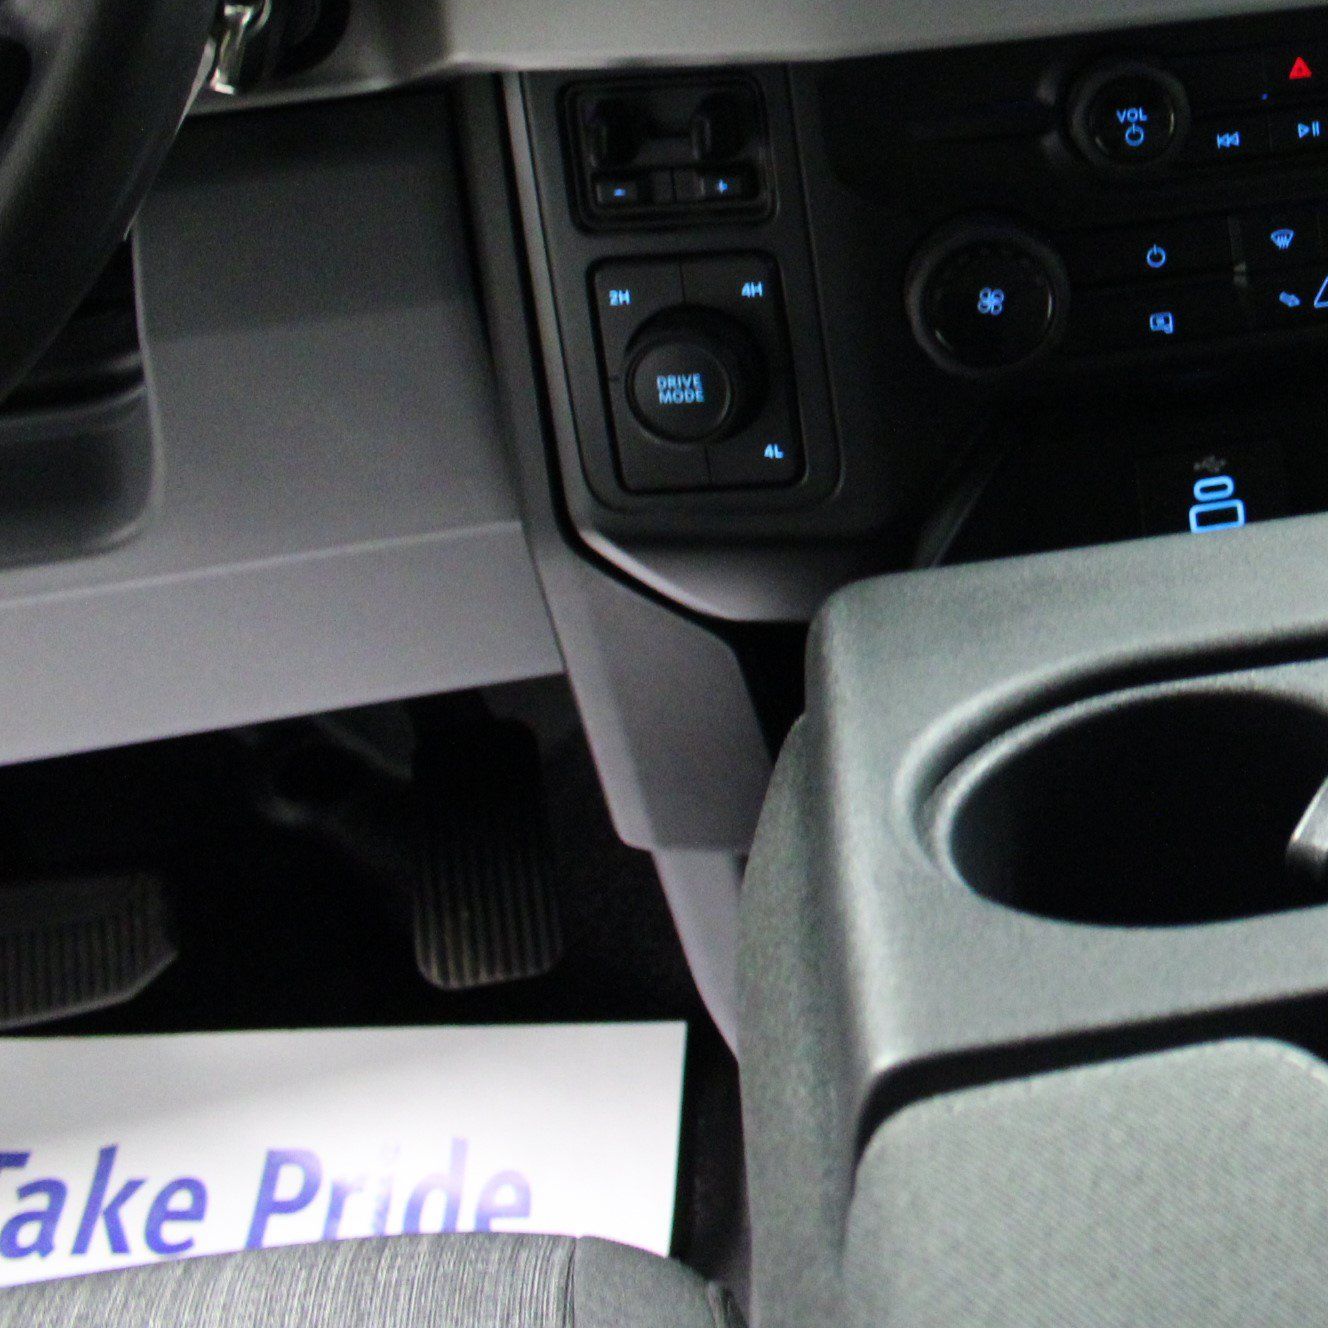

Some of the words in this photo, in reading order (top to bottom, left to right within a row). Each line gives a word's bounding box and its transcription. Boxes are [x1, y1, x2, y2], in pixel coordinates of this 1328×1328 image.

[1116, 107, 1148, 124] VOL
[609, 289, 631, 306] 2H
[741, 282, 764, 298] 4H
[656, 373, 703, 389] DRIVE
[658, 389, 705, 404] MODE
[763, 443, 785, 459] 4L
[245, 1137, 532, 1250] Pride
